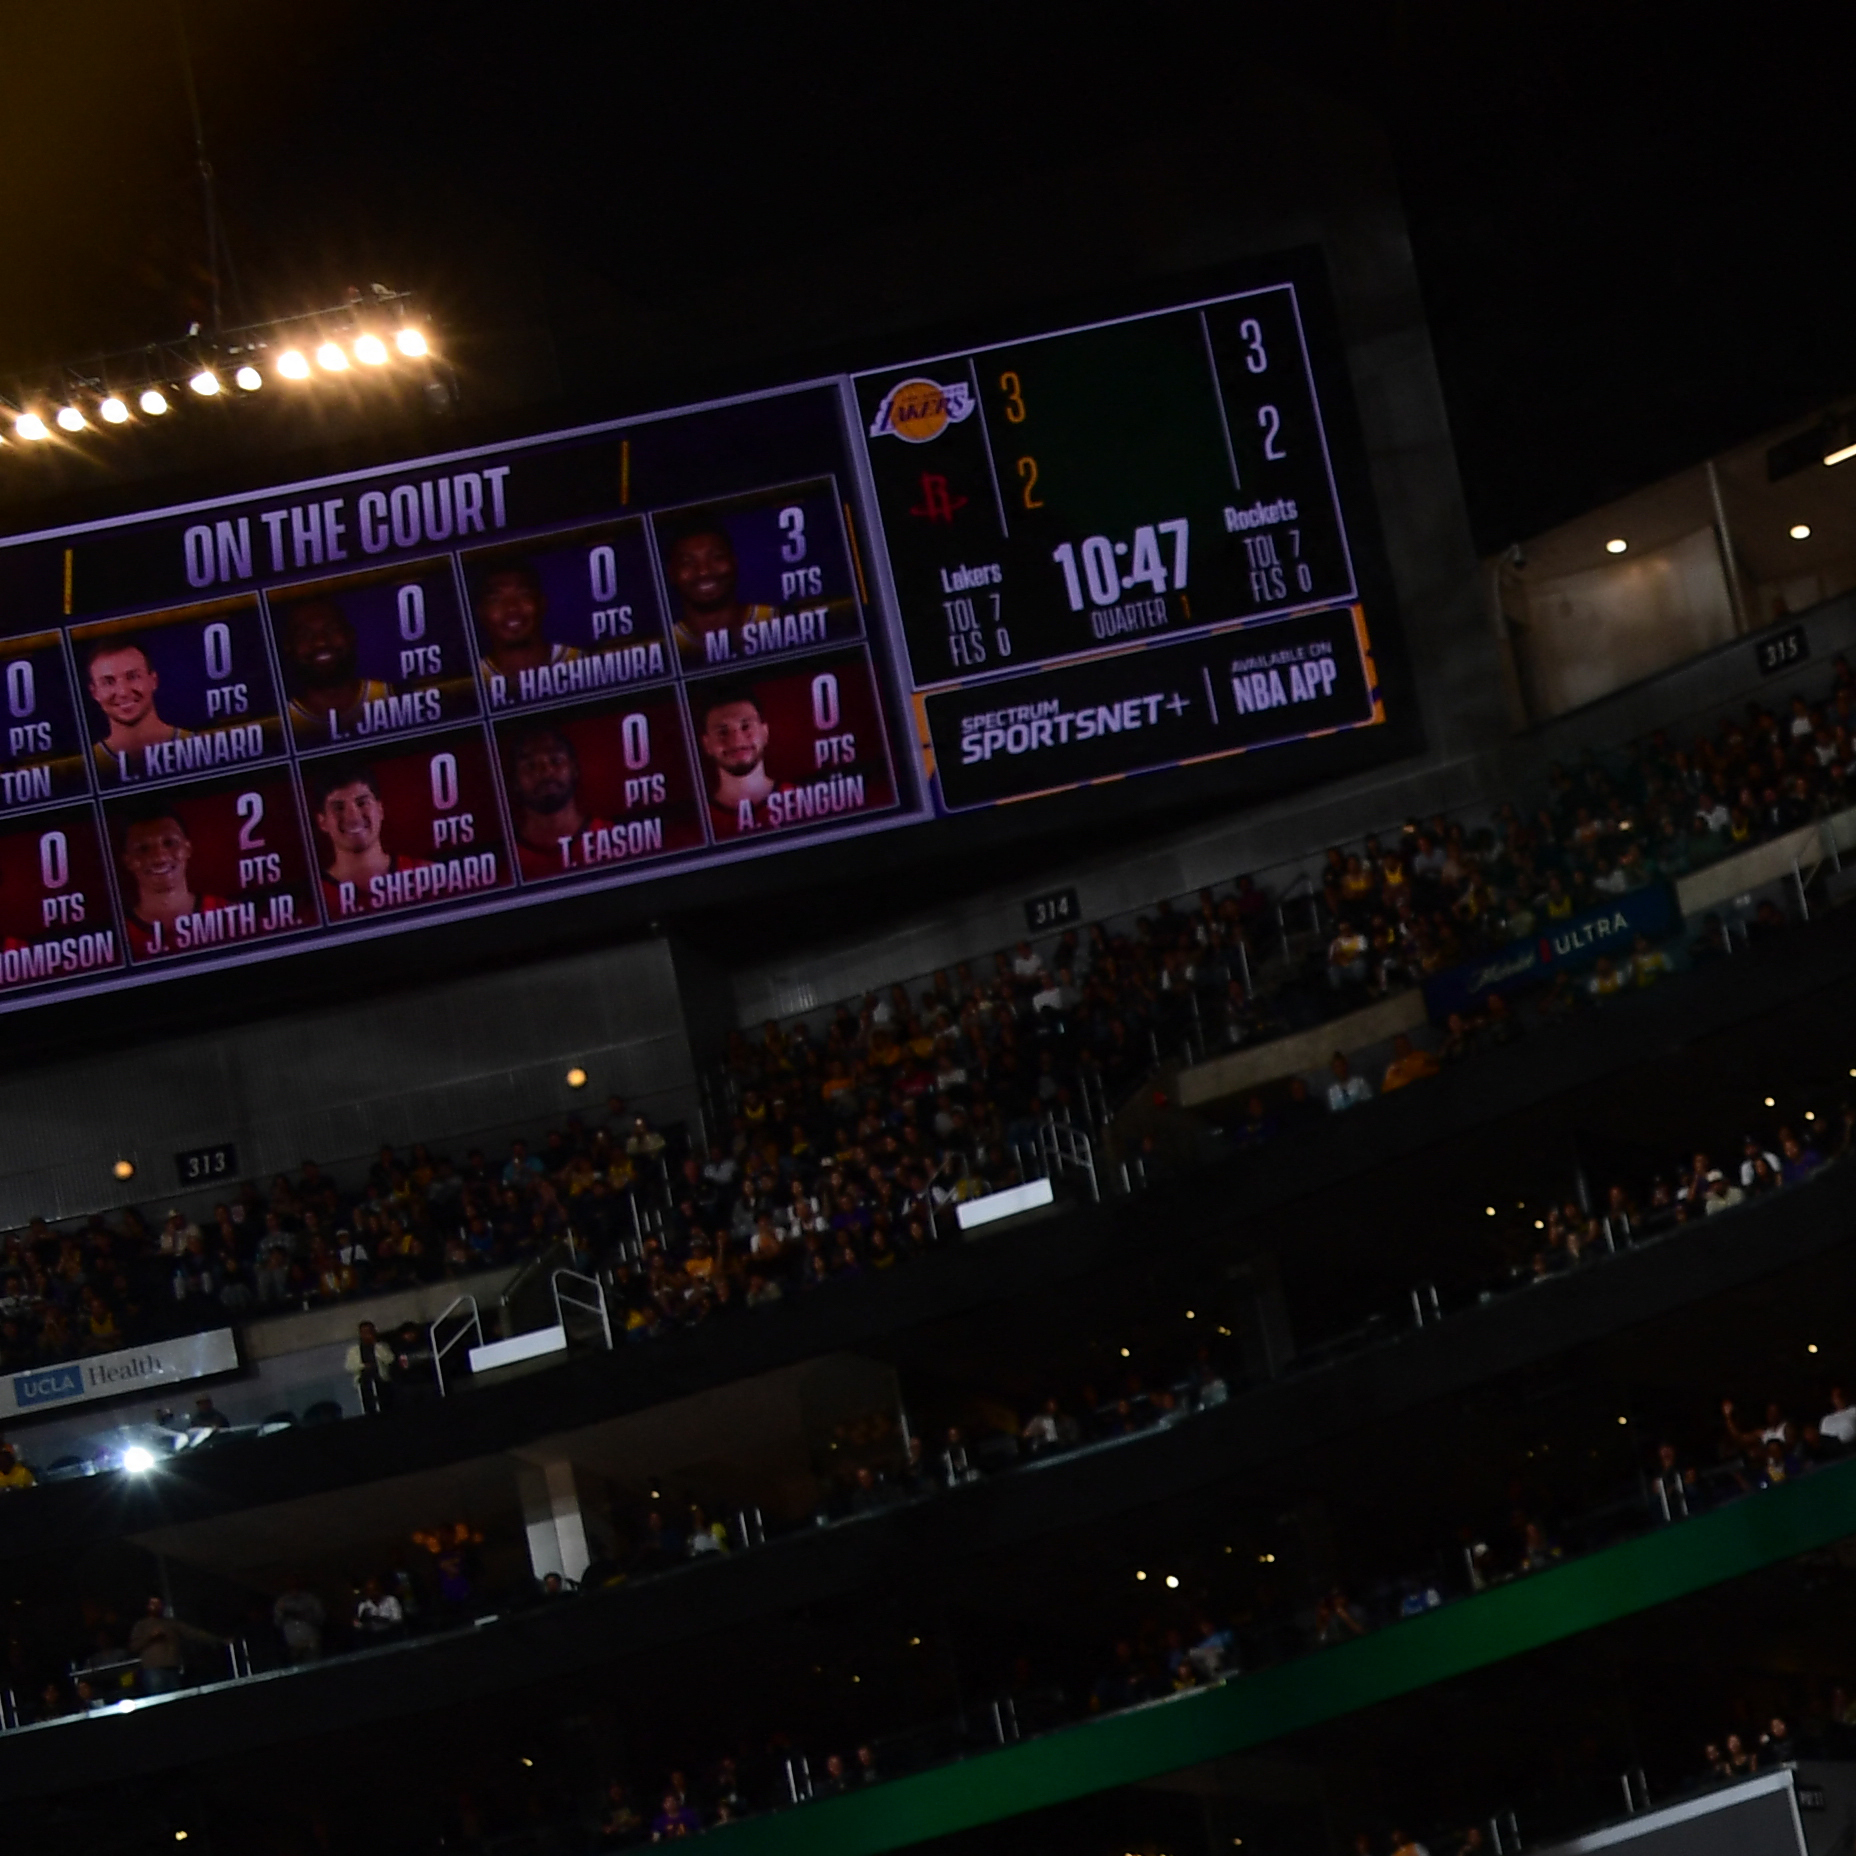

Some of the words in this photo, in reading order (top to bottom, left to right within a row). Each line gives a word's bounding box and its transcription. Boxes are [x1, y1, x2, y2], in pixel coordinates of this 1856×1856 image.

[1240, 318, 1269, 374] 3
[999, 371, 1028, 424] 3
[1257, 405, 1288, 461] 2
[1016, 456, 1045, 509] 2
[183, 516, 253, 588] ON
[260, 498, 347, 572] THE
[357, 465, 511, 554] COURT
[777, 506, 807, 563] 3
[1223, 499, 1299, 533] Rockets
[588, 545, 618, 602] 0
[1051, 517, 1190, 612] 10:47
[1242, 534, 1281, 570] TOL
[1288, 530, 1301, 558] 7
[781, 565, 823, 600] PTS
[940, 562, 1002, 594] Lakers
[1249, 570, 1288, 604] FLS
[1295, 564, 1313, 594] 0
[397, 584, 427, 641] 0
[592, 605, 633, 640] PTS
[705, 628, 737, 663] M.
[742, 607, 829, 654] SMART
[943, 600, 981, 634] TOL
[989, 593, 1001, 622] 7
[1091, 598, 1169, 640] QUARTER
[203, 622, 233, 680] 0
[400, 644, 442, 679] PTS
[949, 635, 987, 667] FLS
[994, 627, 1012, 657] 0
[1230, 647, 1308, 675] AVAILABLE
[1313, 640, 1333, 657] ON
[1767, 635, 1798, 668] 315
[6, 660, 36, 718] 0
[490, 675, 514, 707] R.
[519, 642, 666, 700] HACHIMURA
[1230, 663, 1287, 716] NBA
[1288, 657, 1338, 702] APP
[206, 683, 249, 718] PTS
[328, 707, 350, 740] L.
[357, 688, 442, 736] JAMES
[811, 673, 840, 730] 0
[960, 698, 1059, 737] SPECTRUM
[9, 721, 52, 756] PTS
[118, 750, 139, 782] L.
[145, 724, 264, 775] KENNARD
[621, 712, 650, 770] 0
[815, 733, 856, 768] PTS
[430, 752, 459, 810] 0
[625, 773, 667, 808] PTS
[236, 792, 266, 850] 2
[433, 813, 475, 849] PTS
[738, 799, 762, 831] A.
[40, 831, 69, 888] 0
[557, 835, 577, 868] T.
[582, 817, 663, 863] EASON
[239, 853, 281, 889] PTS
[339, 881, 363, 914] R.
[369, 852, 497, 907] SHEPPARD
[42, 892, 85, 928] PTS
[147, 921, 169, 954] J.
[175, 901, 256, 948] SMITH
[262, 894, 303, 928] JR.
[1552, 911, 1628, 956] ULTRA
[0, 930, 114, 985] OMPSON
[188, 1152, 226, 1178] 313
[24, 1377, 76, 1400] UCLA
[88, 1357, 162, 1389] Health
